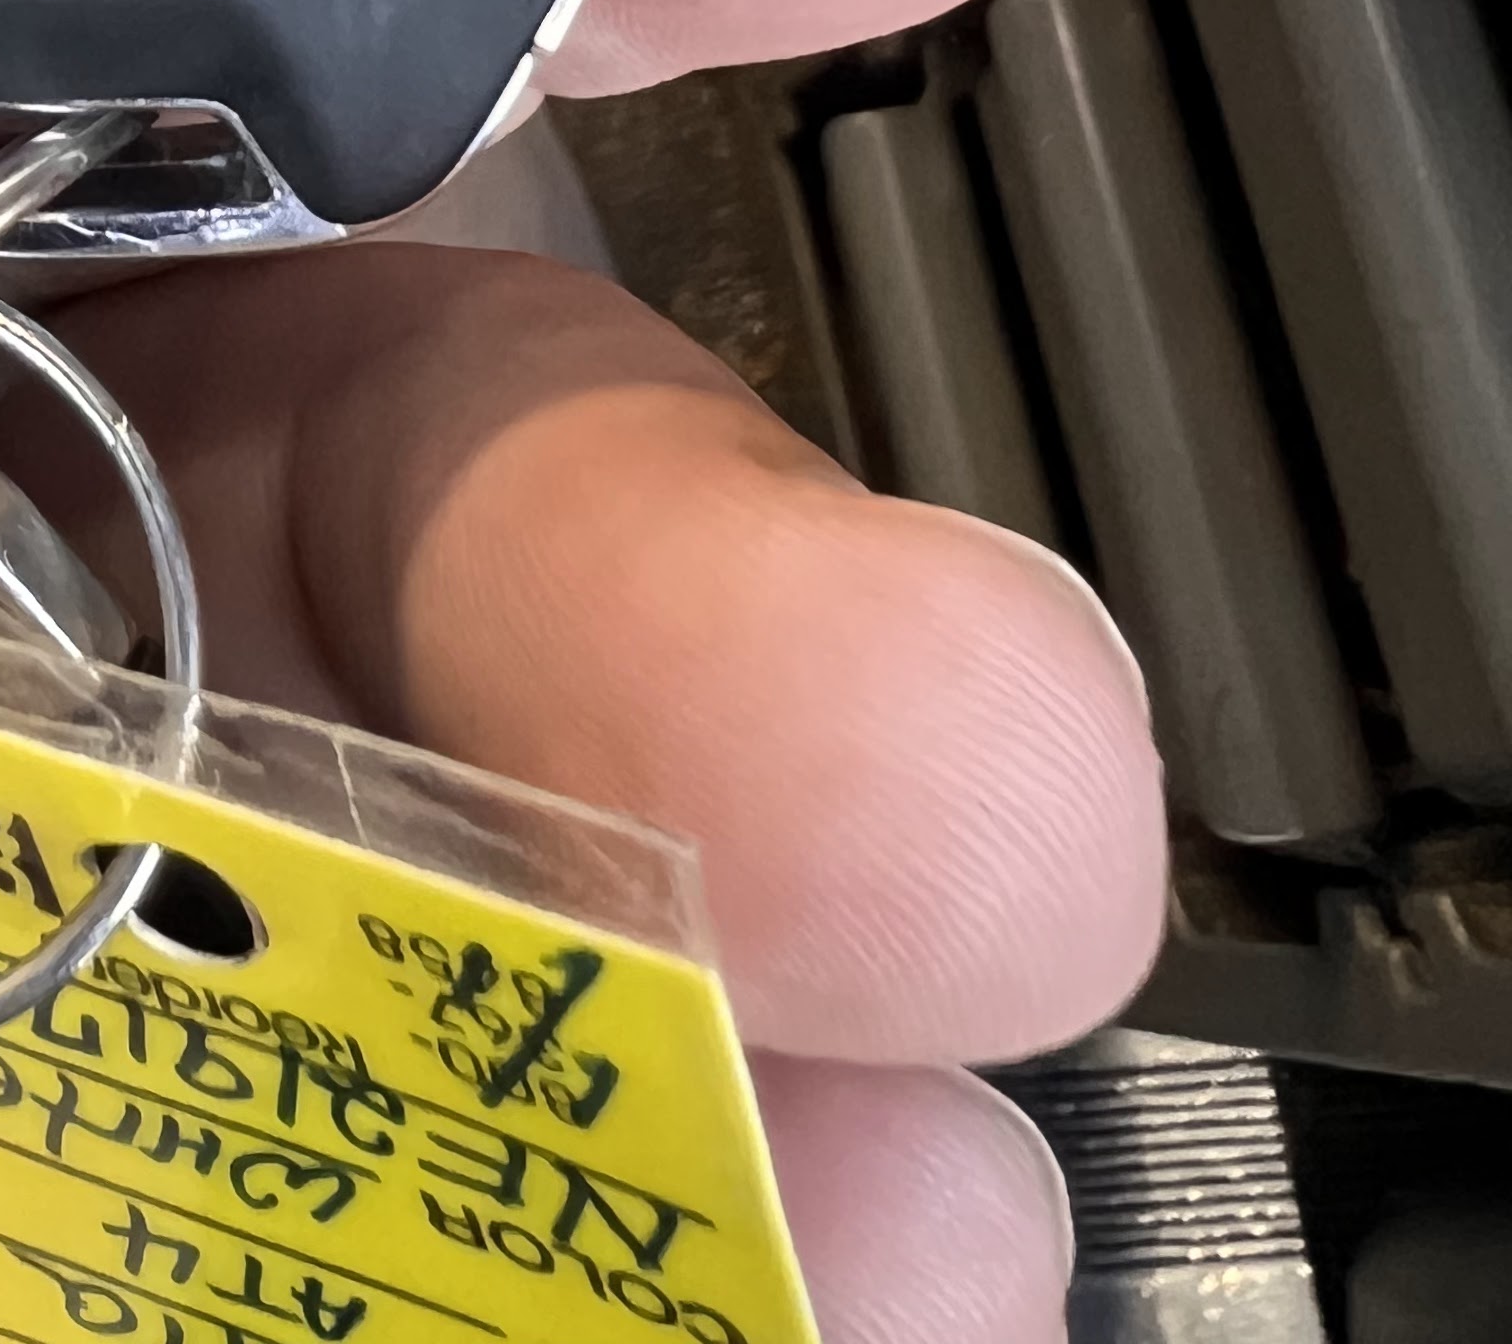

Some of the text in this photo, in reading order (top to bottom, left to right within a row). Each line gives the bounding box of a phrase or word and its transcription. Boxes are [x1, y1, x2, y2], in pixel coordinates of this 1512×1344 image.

[102, 1200, 367, 1342] AT4
[417, 1132, 679, 1277] NE
[419, 1189, 749, 1344] COLOR
